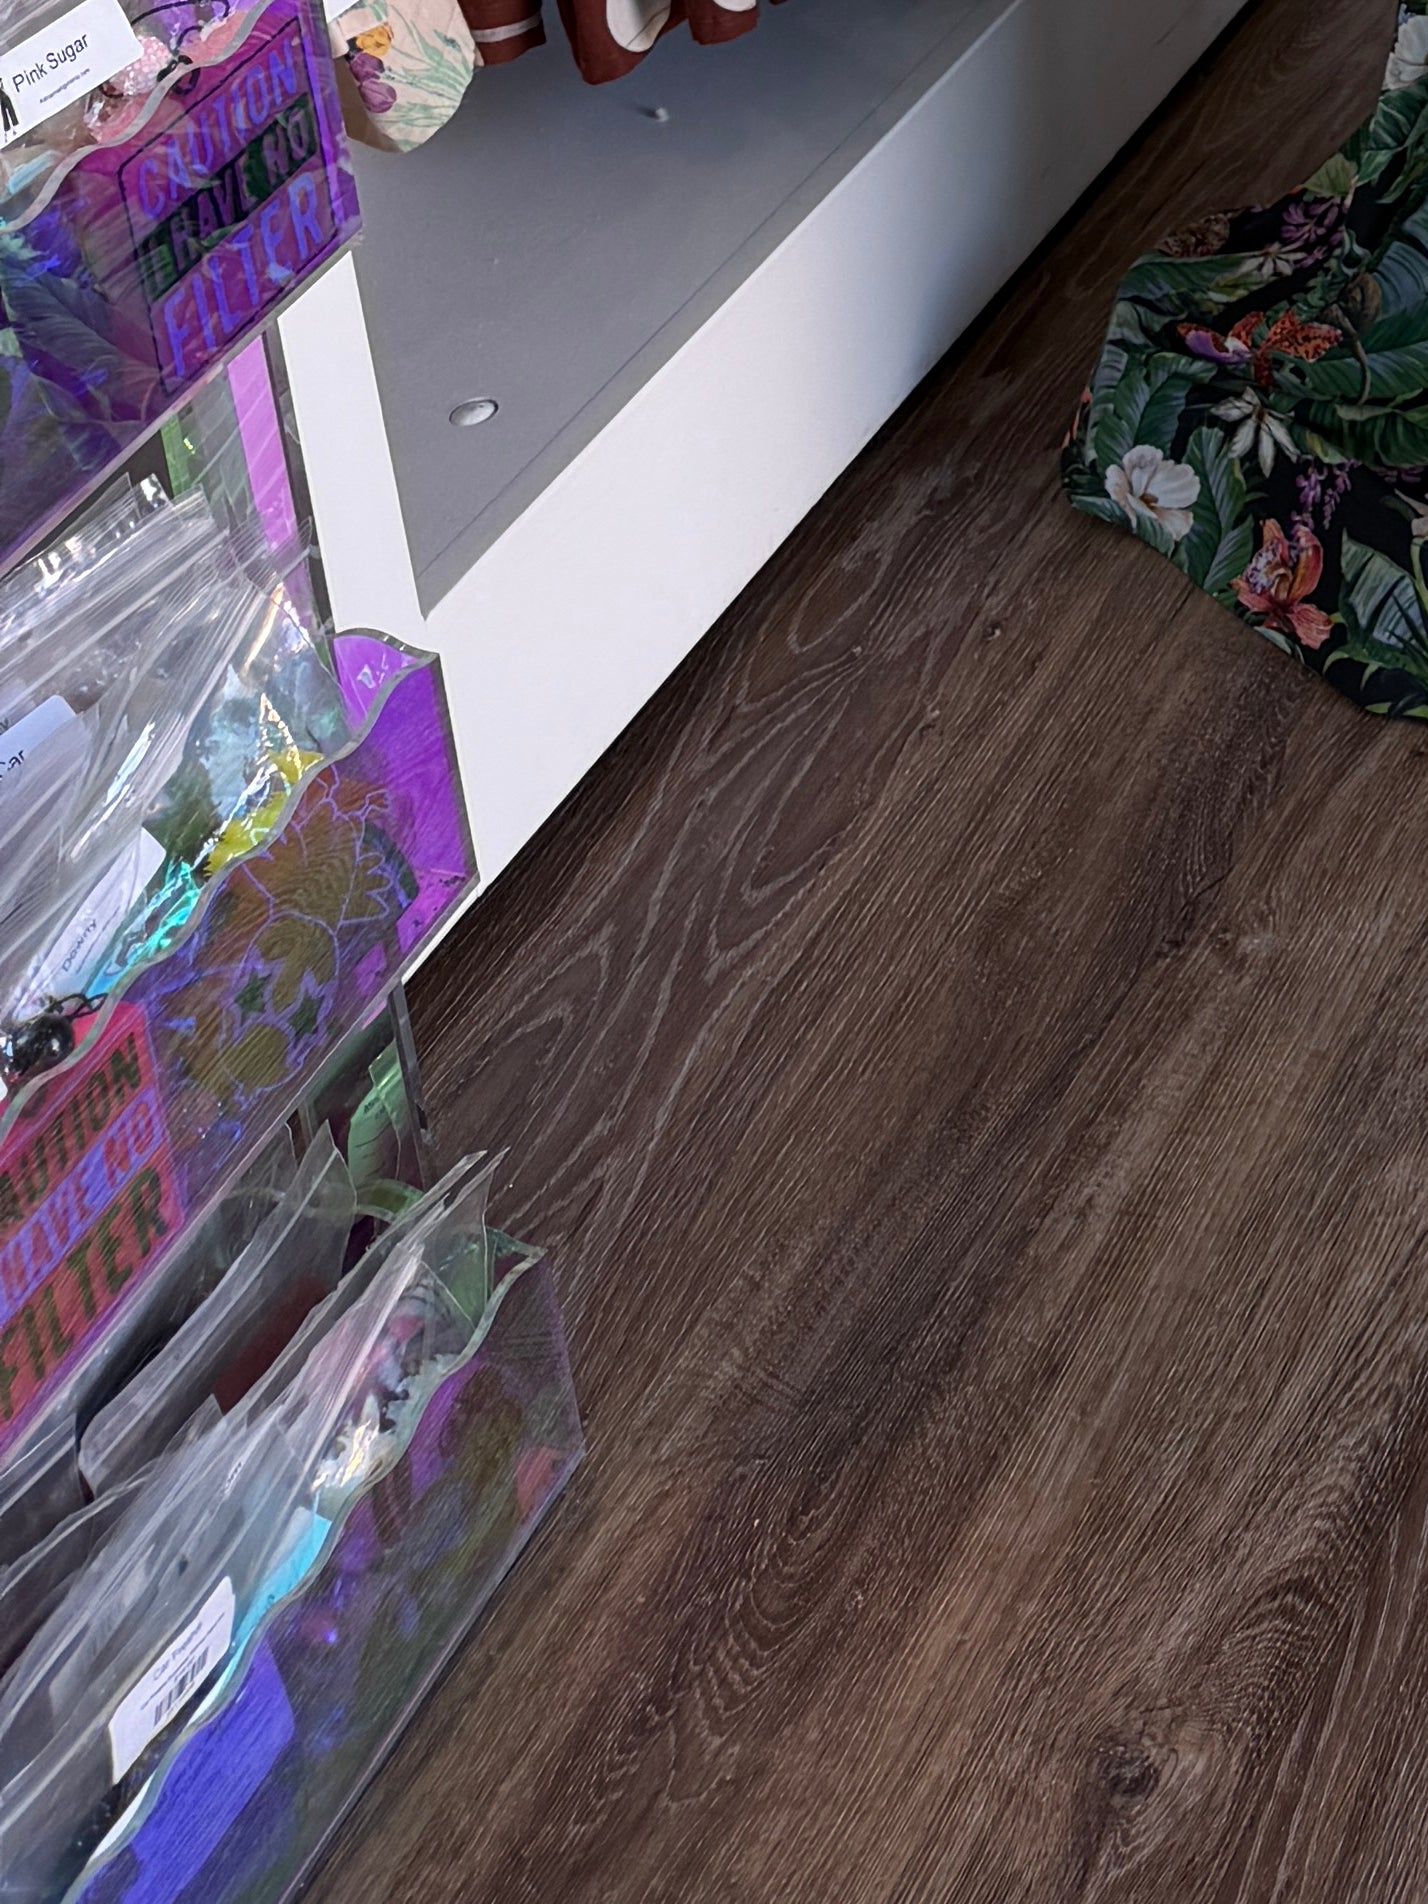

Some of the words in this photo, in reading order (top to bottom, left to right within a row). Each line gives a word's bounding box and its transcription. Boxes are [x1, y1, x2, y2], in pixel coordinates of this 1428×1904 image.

[12, 61, 48, 94] Pink
[46, 34, 90, 71] Sugar
[138, 42, 297, 220] CAUTION
[162, 172, 325, 379] FILTER
[61, 918, 98, 973] Downy
[0, 1031, 142, 1229] AUTION
[102, 1101, 158, 1189] NO
